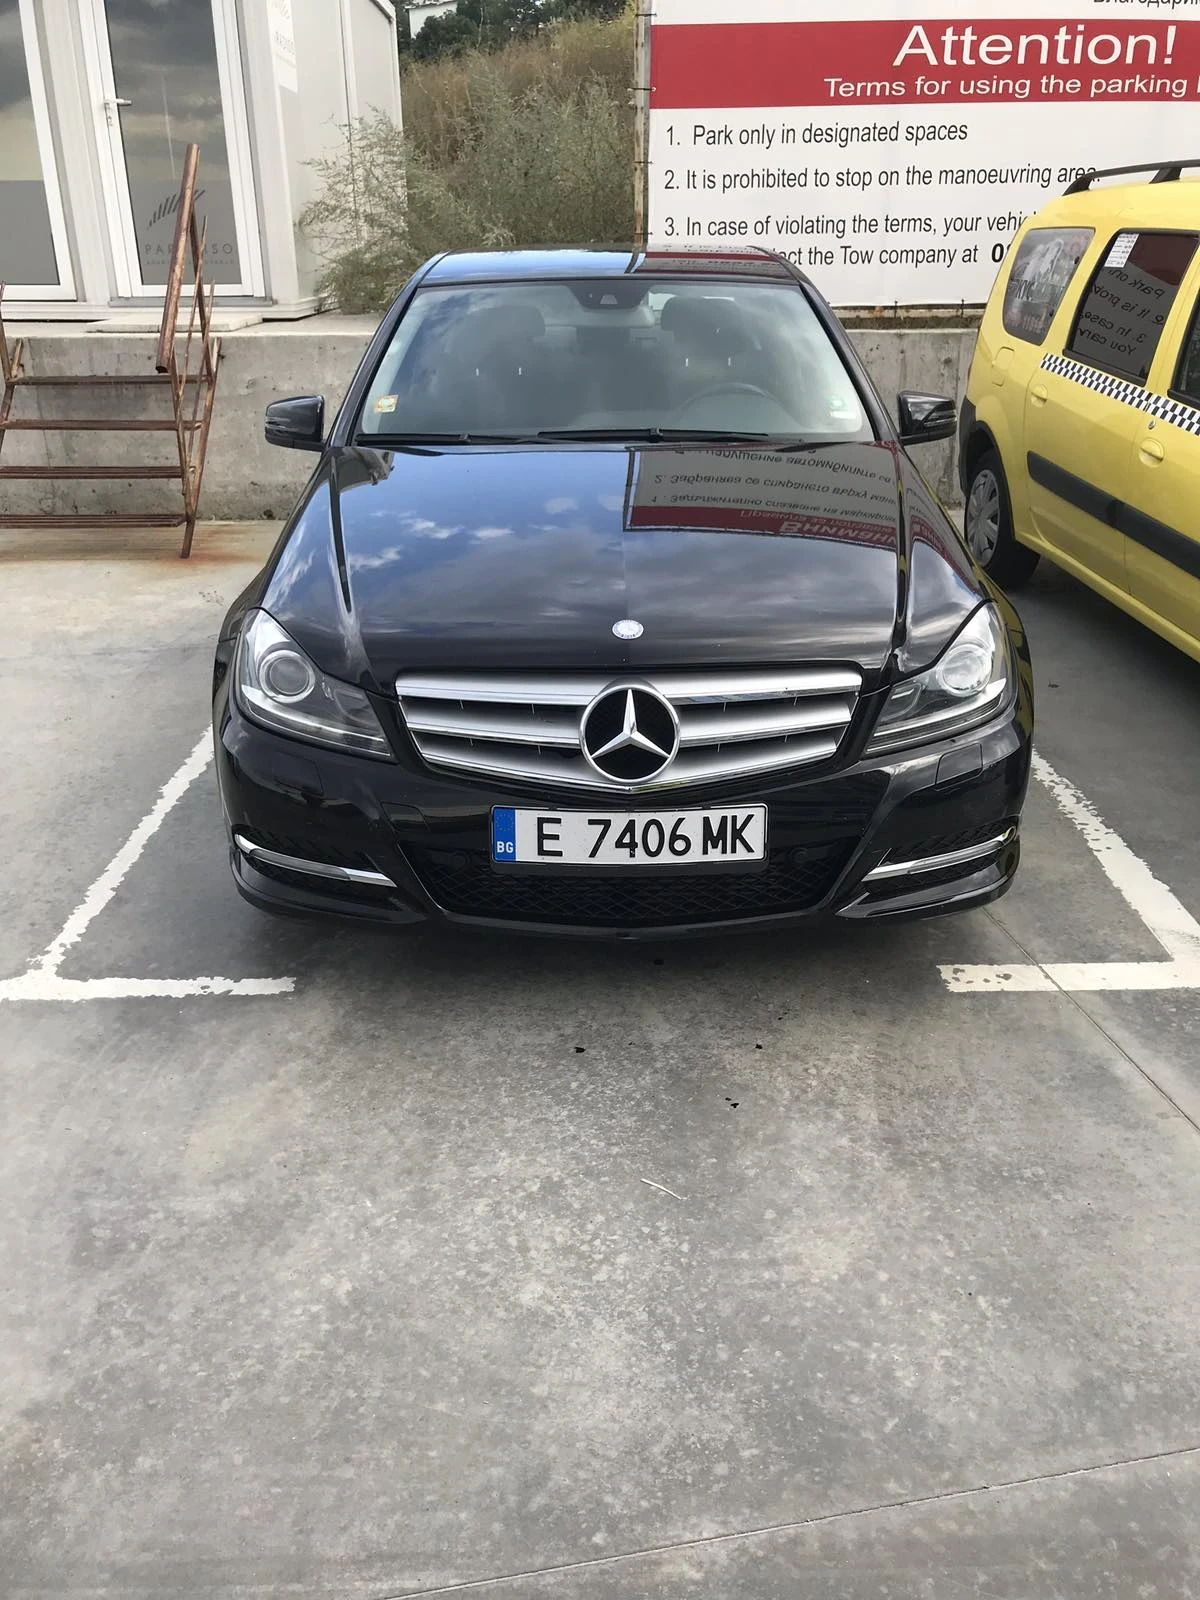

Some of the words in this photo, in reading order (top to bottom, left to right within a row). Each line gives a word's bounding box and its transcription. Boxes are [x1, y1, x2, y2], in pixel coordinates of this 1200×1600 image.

[893, 24, 1177, 66] Attention!
[823, 77, 906, 97] Terms
[915, 76, 952, 96] for
[960, 75, 1031, 99] using
[1041, 74, 1081, 94] the
[1090, 74, 1188, 98] parking
[666, 125, 681, 146] 1.
[693, 124, 734, 146] Park
[739, 123, 776, 150] only
[781, 123, 797, 145] in
[802, 121, 900, 148] designated
[905, 123, 969, 146] spaces
[664, 169, 680, 190] 2.
[687, 169, 698, 190] It
[703, 169, 717, 190] is
[722, 168, 808, 194] prohibited
[814, 168, 831, 188] to
[836, 167, 873, 191] stop
[878, 170, 900, 187] on
[906, 165, 933, 186] the
[938, 163, 1052, 188] manoeuvring
[664, 216, 680, 237] 3.
[687, 216, 702, 236] In
[707, 219, 749, 236] case
[754, 215, 772, 236] of
[776, 214, 847, 239] violating
[852, 214, 879, 234] the
[884, 214, 938, 236] terms,
[943, 214, 983, 239] your
[808, 246, 835, 266] the
[840, 245, 874, 265] Tow
[878, 245, 958, 269] company
[962, 244, 979, 264] at
[496, 841, 514, 854] BG
[536, 816, 563, 857] E
[587, 816, 692, 858] 7406
[702, 813, 755, 856] MK
